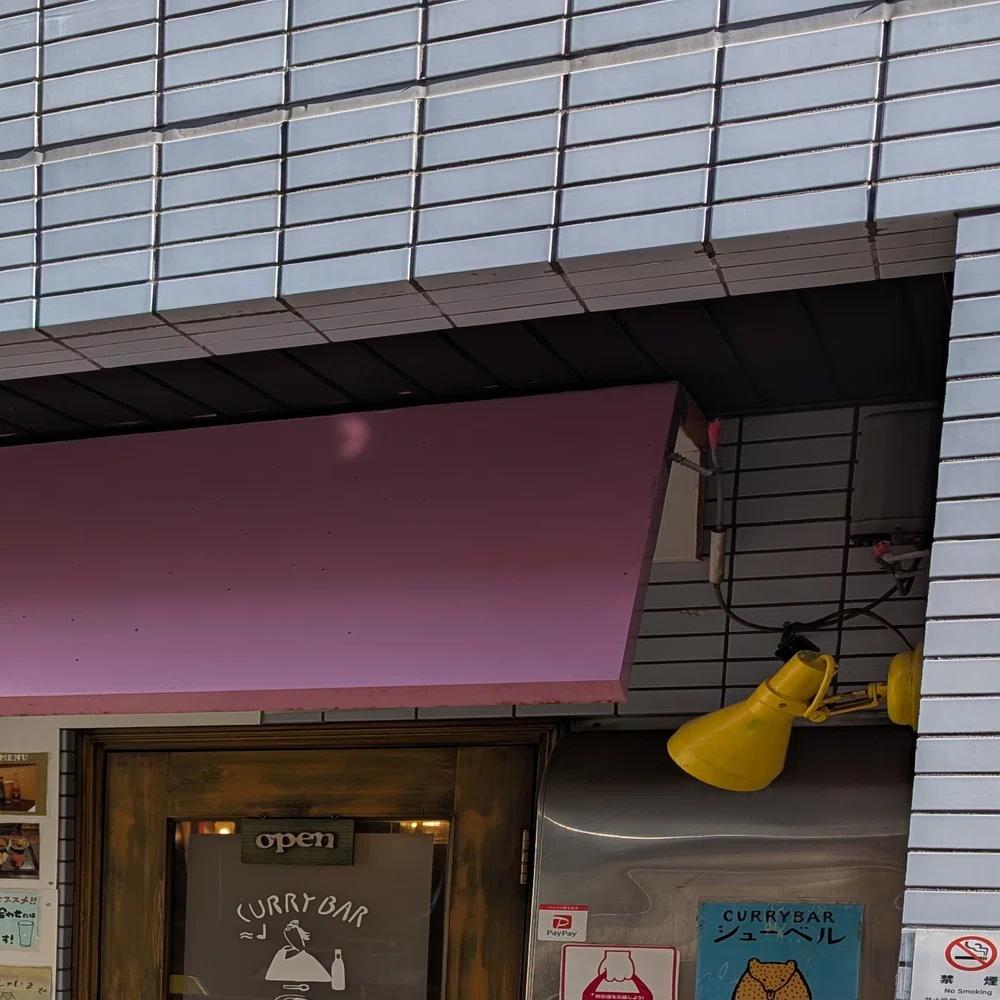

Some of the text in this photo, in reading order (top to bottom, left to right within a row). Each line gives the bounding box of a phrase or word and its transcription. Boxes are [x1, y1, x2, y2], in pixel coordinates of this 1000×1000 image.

[255, 830, 335, 854] open
[236, 892, 369, 928] CURRY BAR
[723, 909, 836, 924] CURRYBAR
[546, 929, 578, 938] PayPay
[713, 924, 847, 945] シューベル
[957, 988, 993, 997] Smoking
